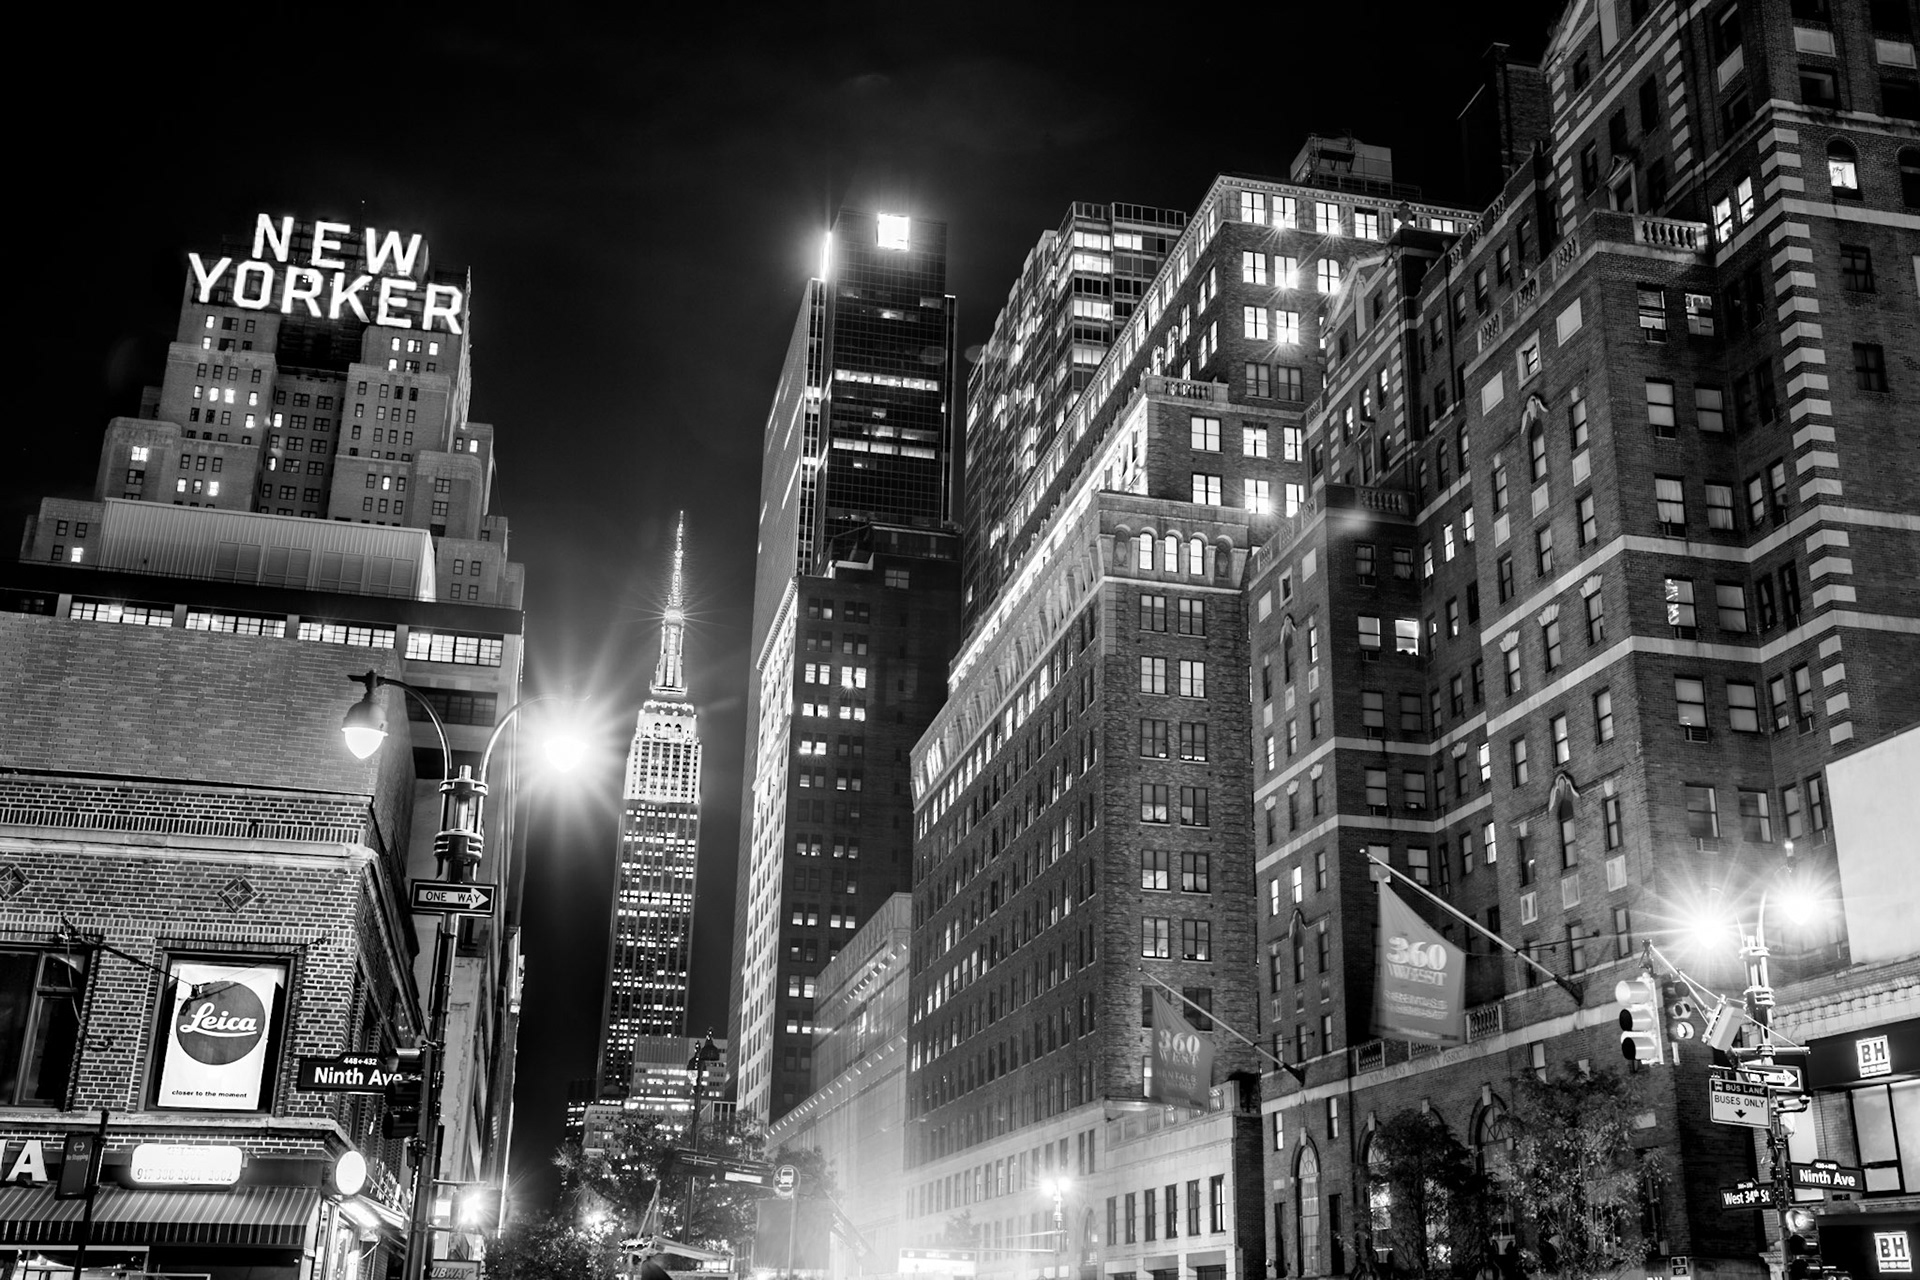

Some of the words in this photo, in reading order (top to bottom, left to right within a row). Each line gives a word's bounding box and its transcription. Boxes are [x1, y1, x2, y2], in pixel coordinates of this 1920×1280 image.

[252, 213, 422, 276] NEW
[188, 253, 463, 335] YORKER
[425, 891, 447, 902] ONE
[457, 893, 481, 903] WAY
[1386, 936, 1447, 971] 360
[180, 1002, 257, 1037] Leica
[1158, 1029, 1200, 1056] 360
[1861, 1041, 1885, 1063] BH
[314, 1067, 364, 1085] Ninth
[1725, 1083, 1741, 1093] BUS
[1743, 1085, 1765, 1095] LANE
[1714, 1094, 1740, 1106] BUSES
[1744, 1097, 1765, 1108] ONLY
[1799, 1169, 1831, 1185] Ninth
[1833, 1172, 1856, 1187] Ave
[1723, 1192, 1744, 1205] West
[1745, 1189, 1759, 1203] 34th
[1761, 1189, 1771, 1203] St
[1880, 1237, 1906, 1258] BH
[430, 1267, 474, 1279] UBWAY
